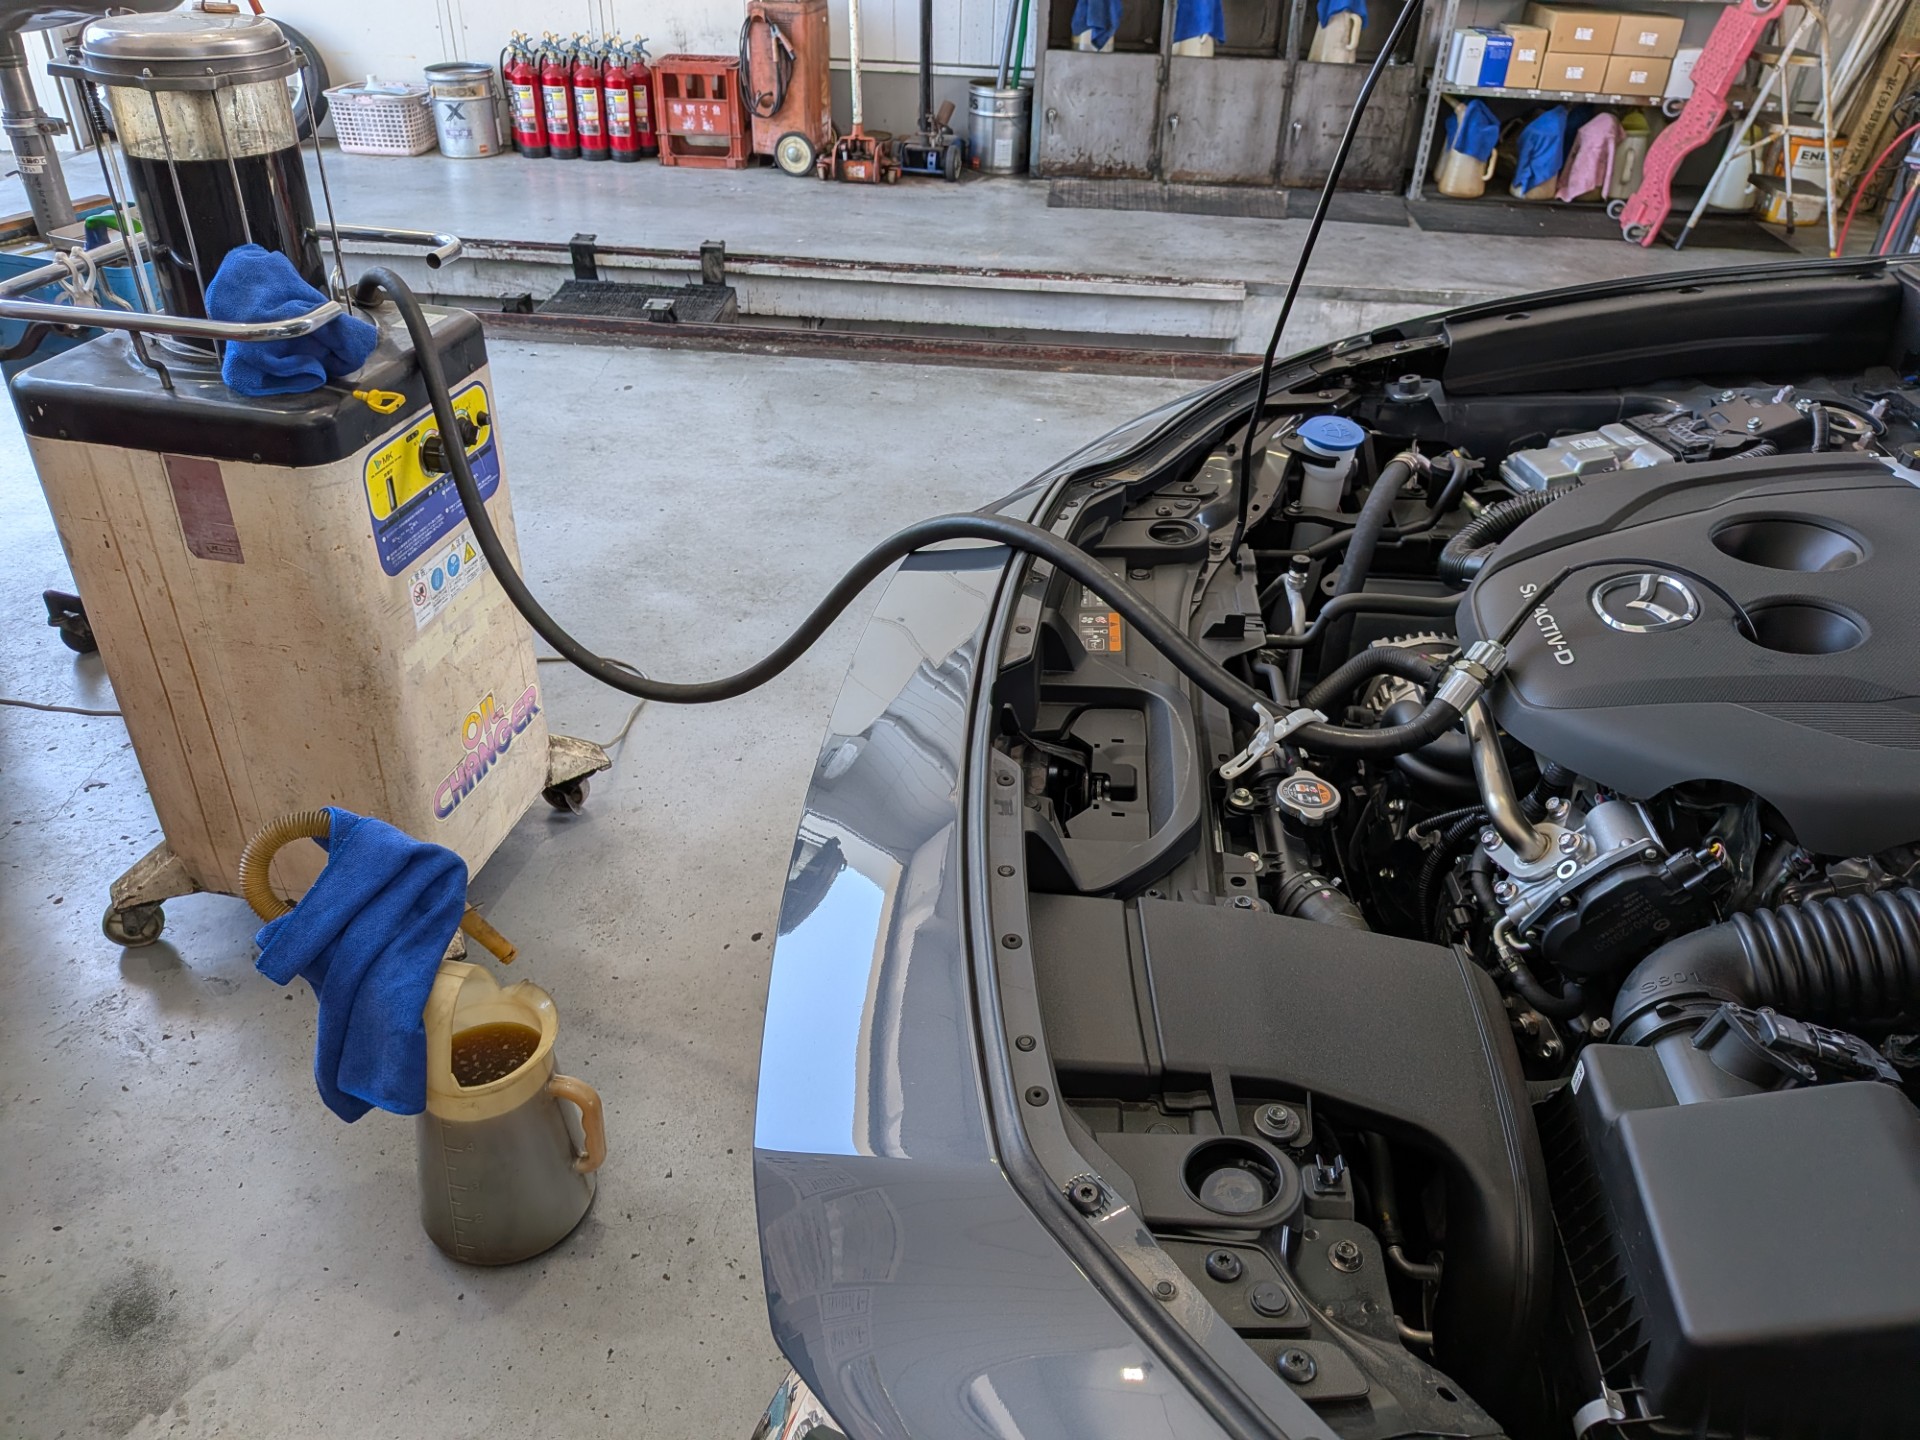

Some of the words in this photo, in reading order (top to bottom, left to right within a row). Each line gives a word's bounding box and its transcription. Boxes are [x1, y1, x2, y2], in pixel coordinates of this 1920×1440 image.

[1519, 583, 1575, 665] SACTIV-D
[434, 685, 541, 820] CHANGER
[462, 693, 505, 750] OIL
